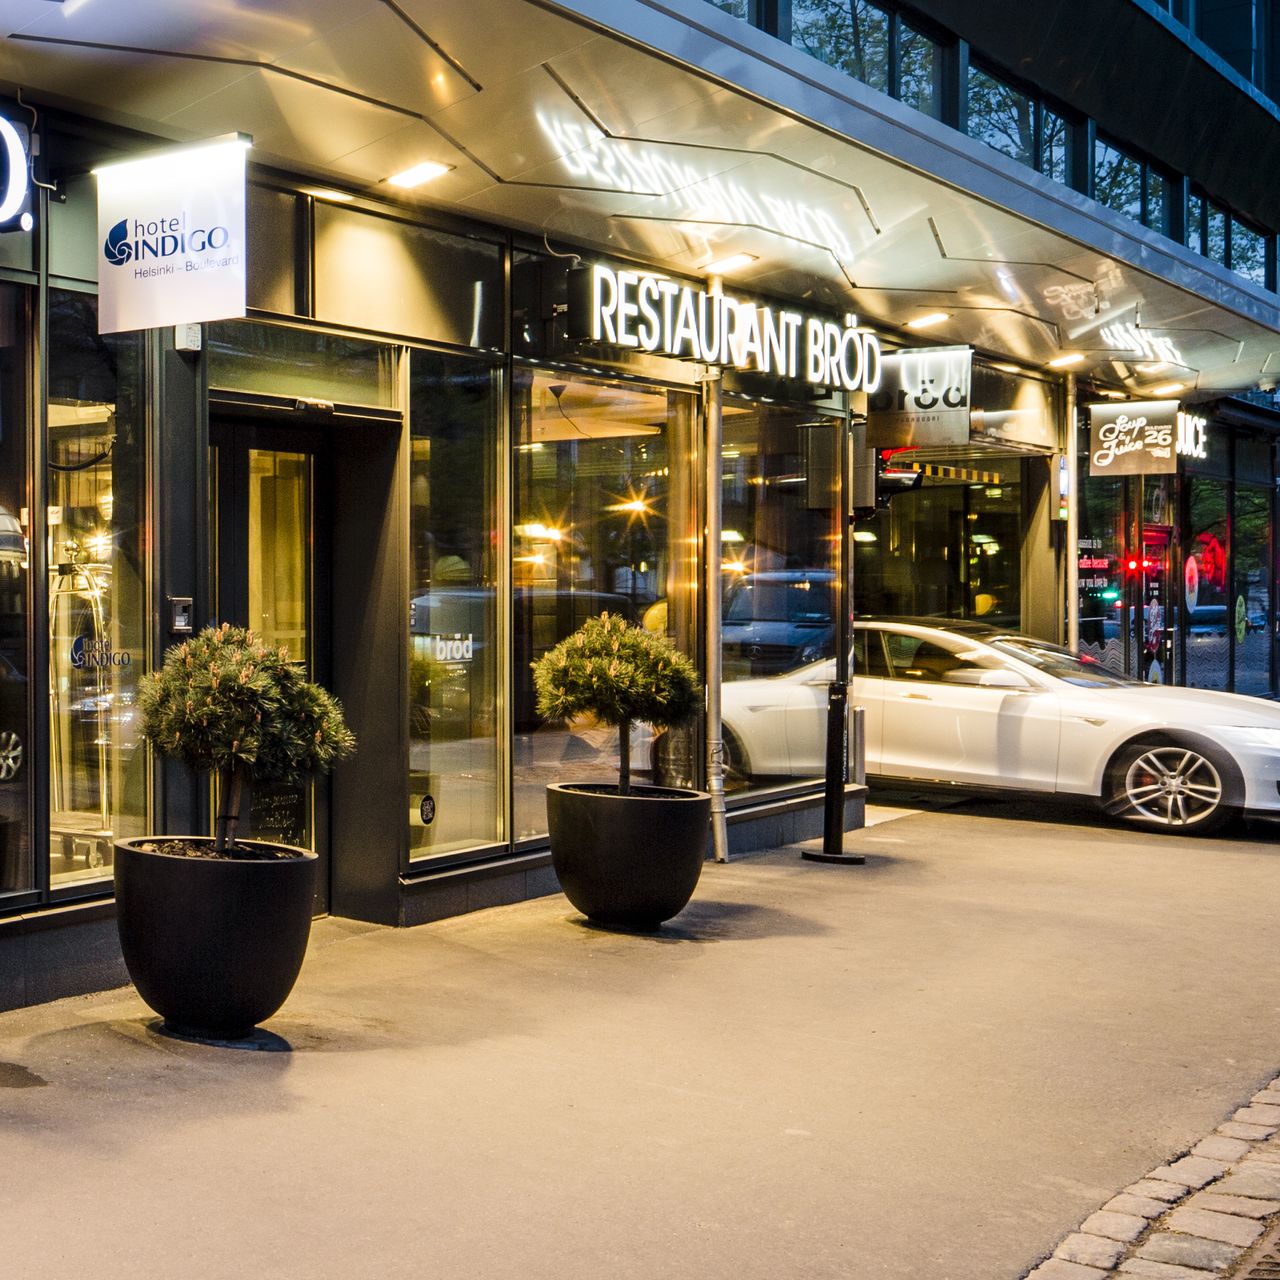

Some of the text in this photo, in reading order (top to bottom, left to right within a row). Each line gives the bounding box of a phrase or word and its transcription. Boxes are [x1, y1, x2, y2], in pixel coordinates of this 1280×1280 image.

[133, 210, 187, 238] hotel
[134, 226, 229, 261] INDIGO
[134, 264, 175, 279] Helsinki
[185, 254, 239, 271] Boulevard
[591, 263, 881, 394] RESTAURANT BRÖD
[1099, 415, 1147, 440] Soup
[1144, 429, 1173, 445] 26
[1093, 439, 1143, 466] Juice
[87, 652, 131, 667] INDIGO
[436, 633, 473, 660] bröd
